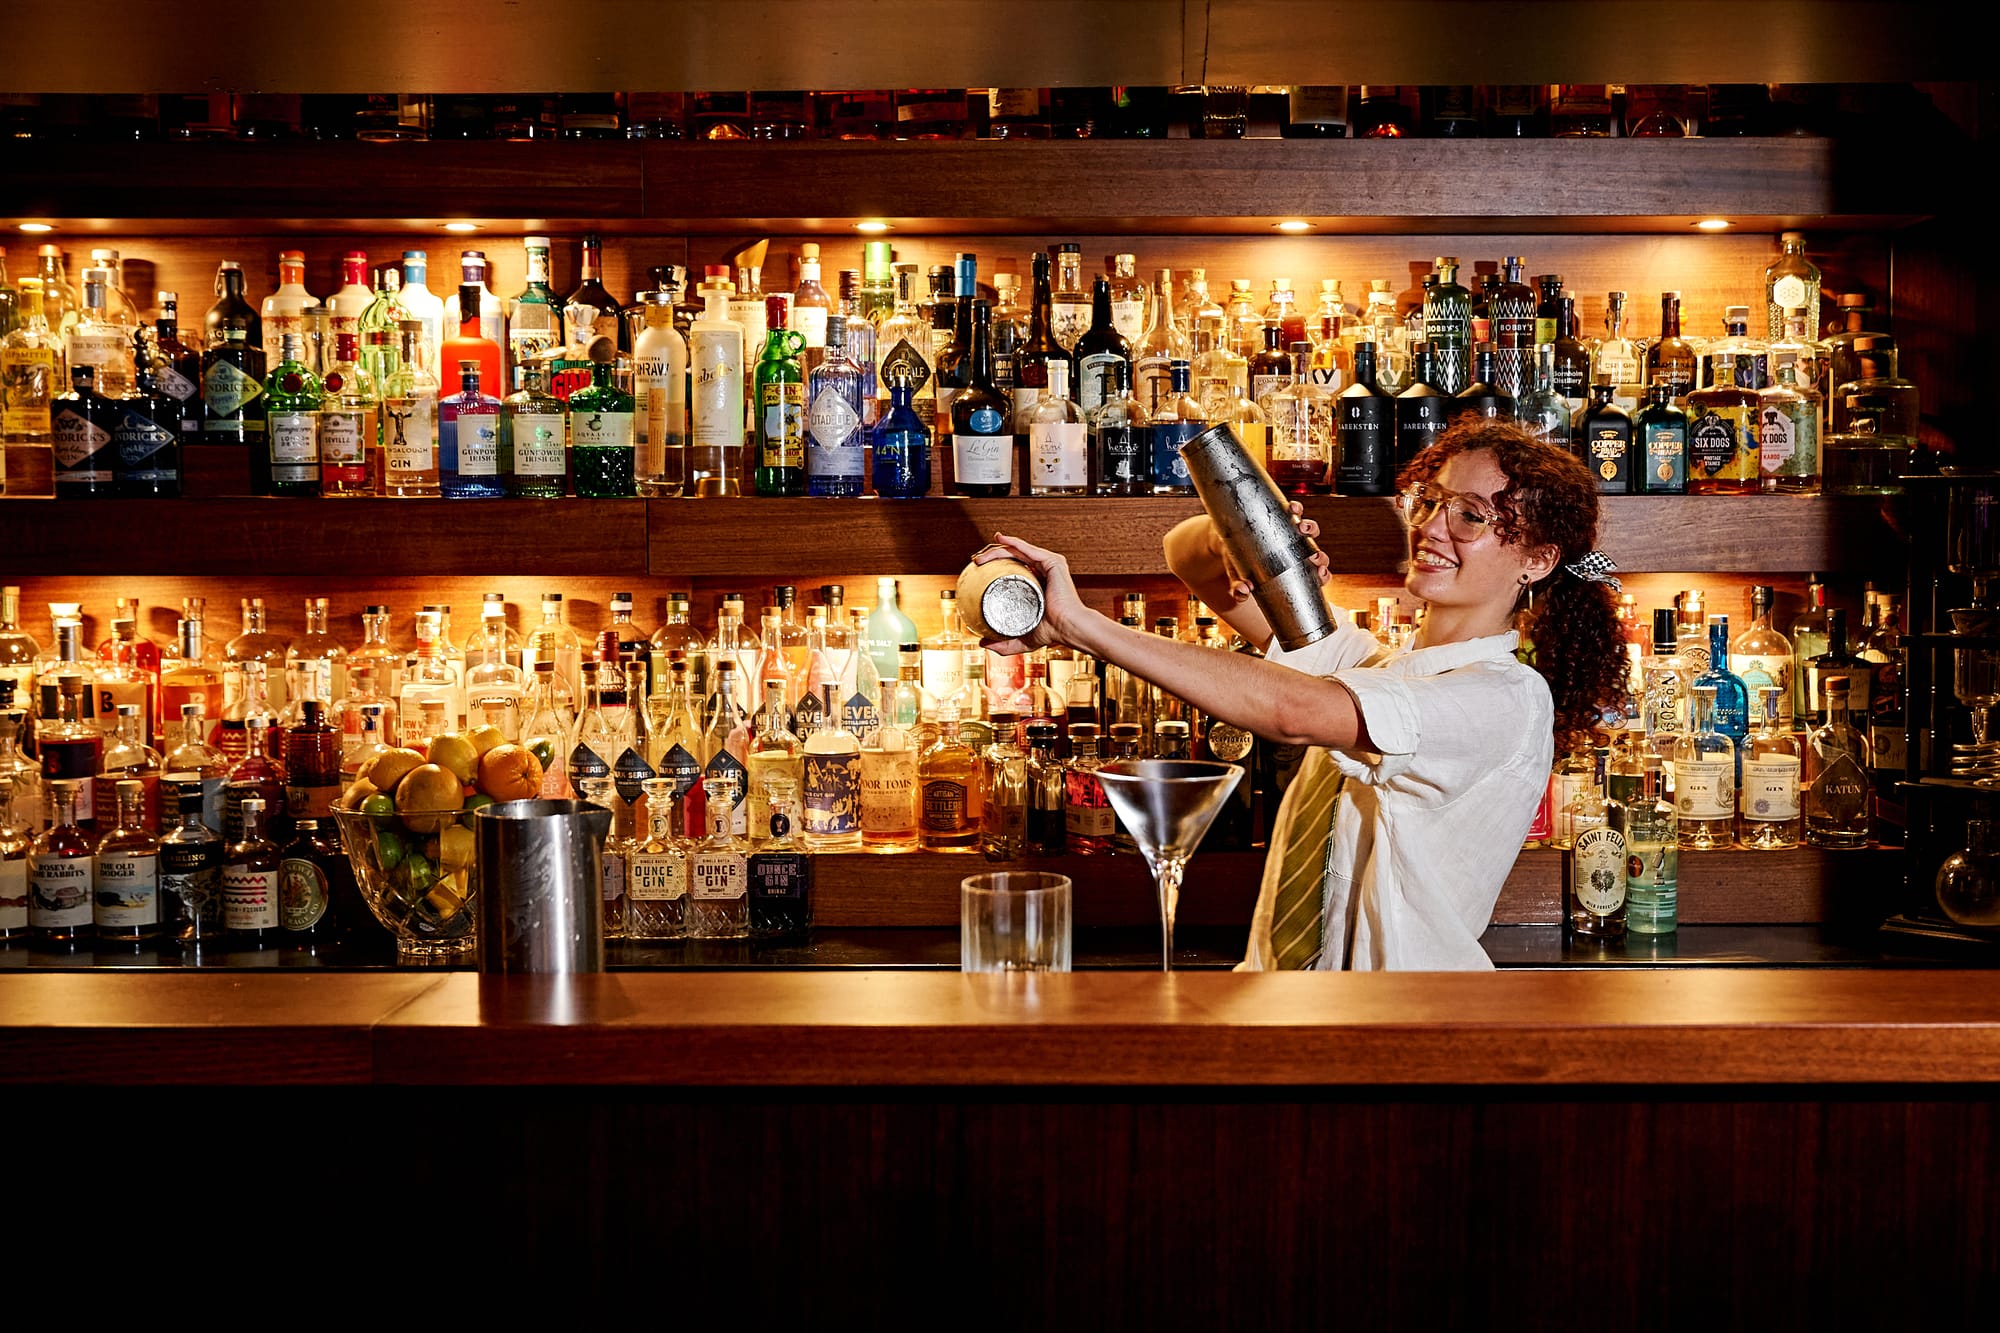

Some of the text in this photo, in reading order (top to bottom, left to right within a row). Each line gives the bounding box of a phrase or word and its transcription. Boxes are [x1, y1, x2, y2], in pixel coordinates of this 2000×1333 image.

[157, 382, 189, 392] RICK'S
[206, 382, 258, 393] NDRICK'S
[1403, 422, 1447, 430] BAREKSTEN
[55, 431, 106, 442] NDRICK'S
[115, 431, 167, 442] NDRICK'S
[1769, 433, 1788, 443] DOGS
[1694, 437, 1730, 448] SIX DOGS
[390, 459, 411, 468] GIN
[100, 691, 114, 713] B
[406, 730, 423, 740] DRY
[884, 779, 912, 789] TOMS
[1578, 831, 1625, 851] SAINT FELIX
[116, 862, 135, 870] OLD
[635, 865, 674, 877] OUNCE
[697, 864, 736, 876] OUNCE
[757, 863, 798, 876] OUNCE
[642, 877, 666, 888] GIN
[705, 876, 729, 887] GIN
[764, 875, 789, 887] GIN
